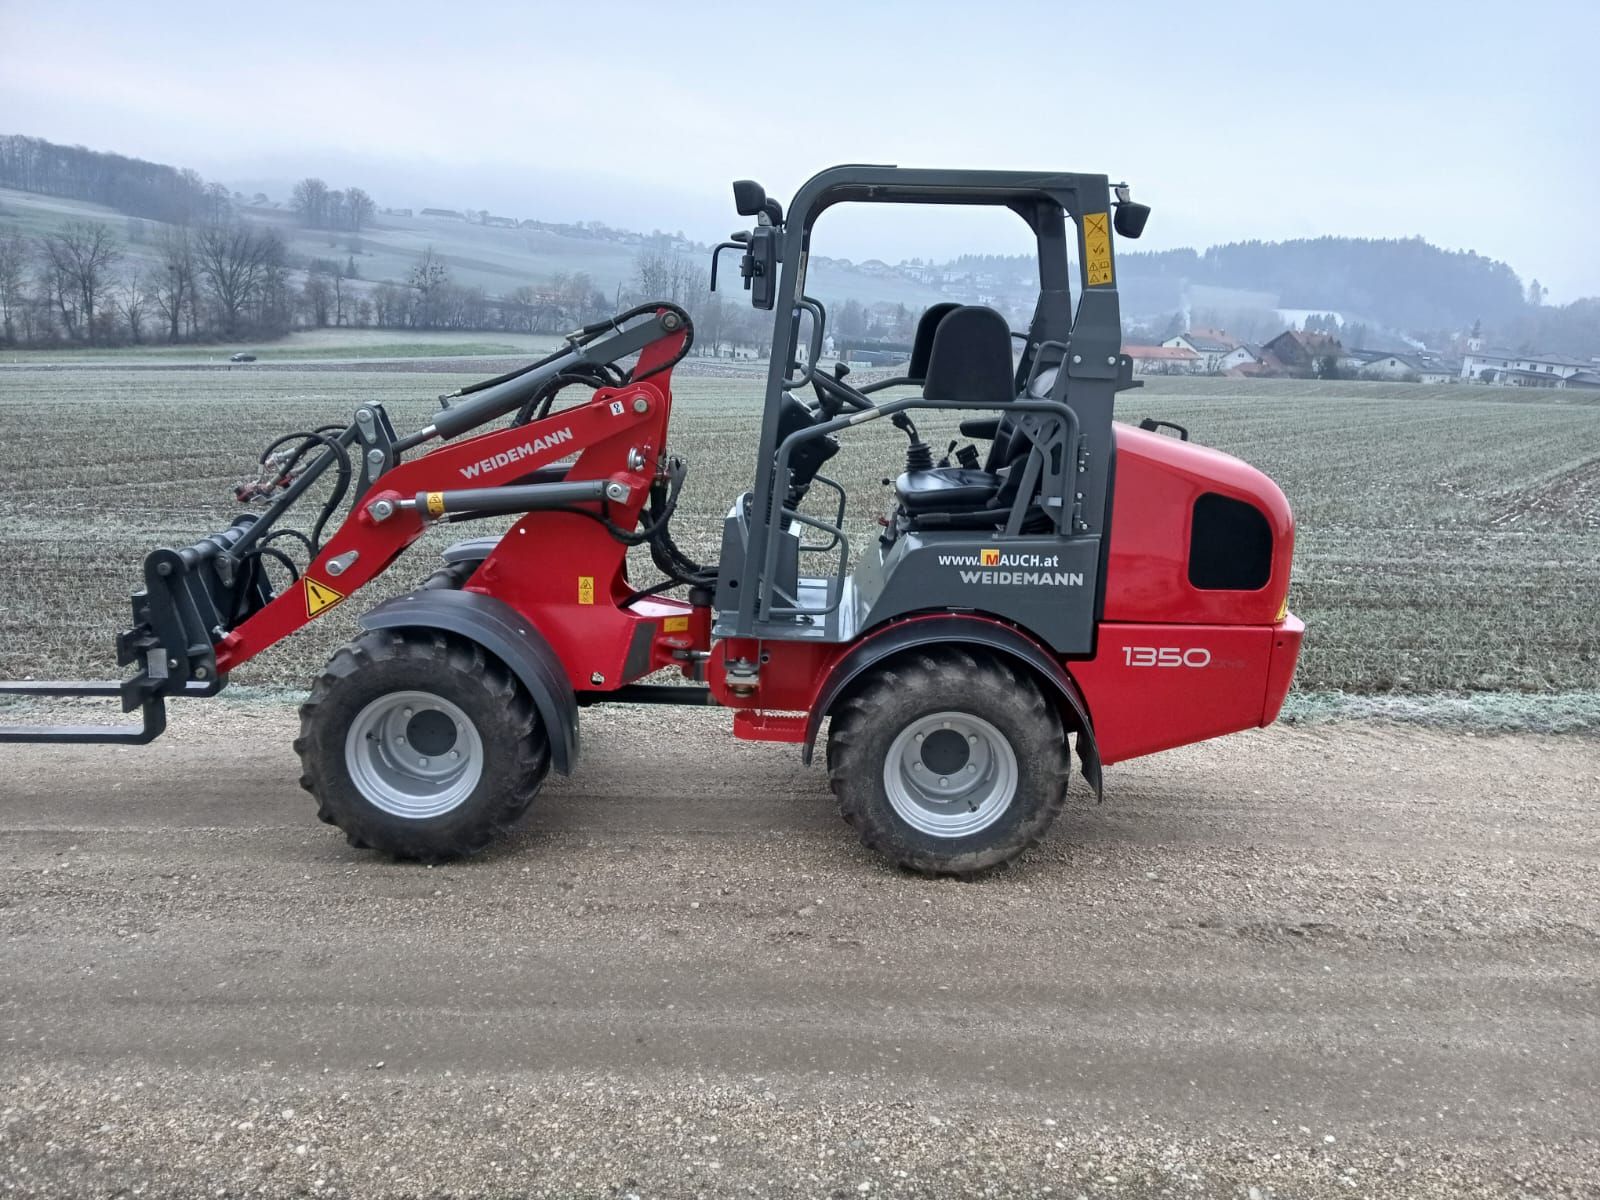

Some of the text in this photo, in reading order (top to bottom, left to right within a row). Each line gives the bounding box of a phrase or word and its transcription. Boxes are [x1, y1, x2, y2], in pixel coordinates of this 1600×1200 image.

[459, 427, 574, 480] WEIDEMANN
[938, 553, 1059, 568] www.MAUCH.at
[959, 570, 1083, 586] WEIDEMANN
[1122, 646, 1211, 668] 1350
